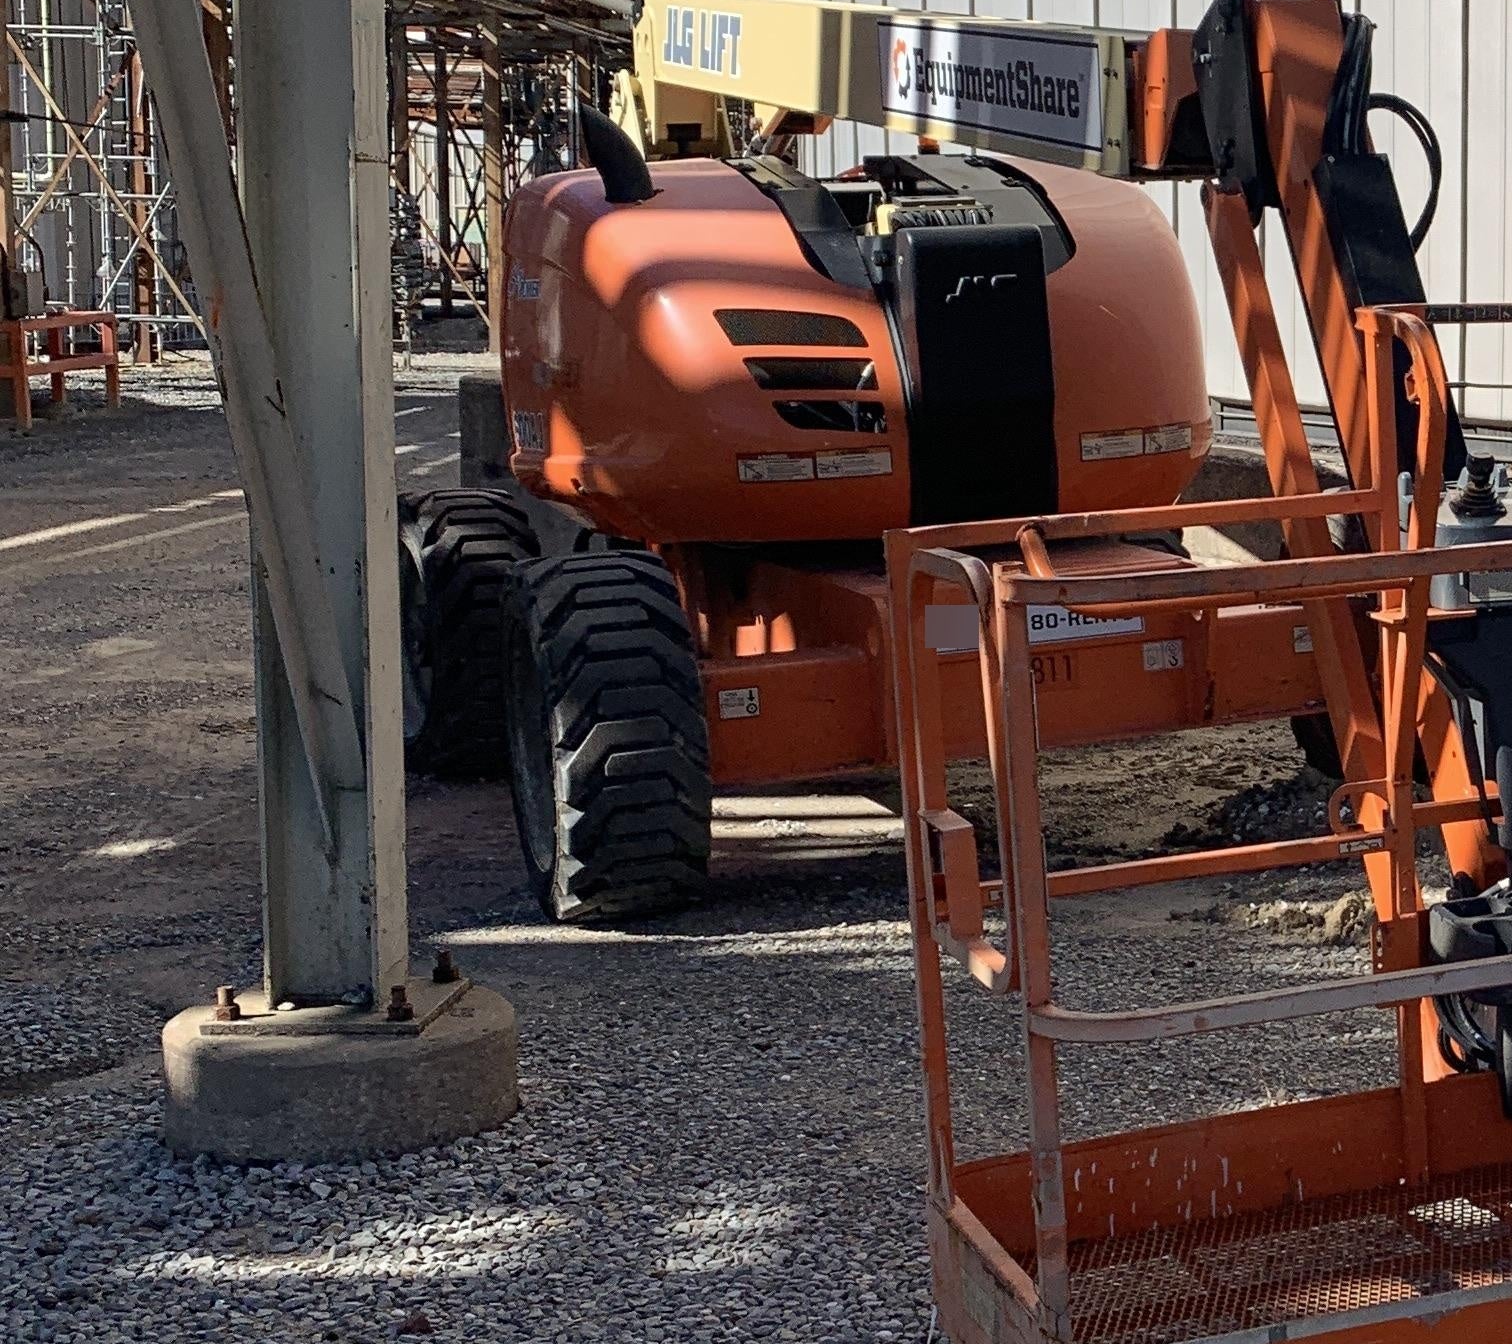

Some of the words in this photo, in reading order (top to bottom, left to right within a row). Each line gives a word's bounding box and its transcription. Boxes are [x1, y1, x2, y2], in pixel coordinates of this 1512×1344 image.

[662, 6, 694, 68] JLG
[699, 10, 742, 77] LIFT
[913, 47, 1080, 119] EquipmentShare
